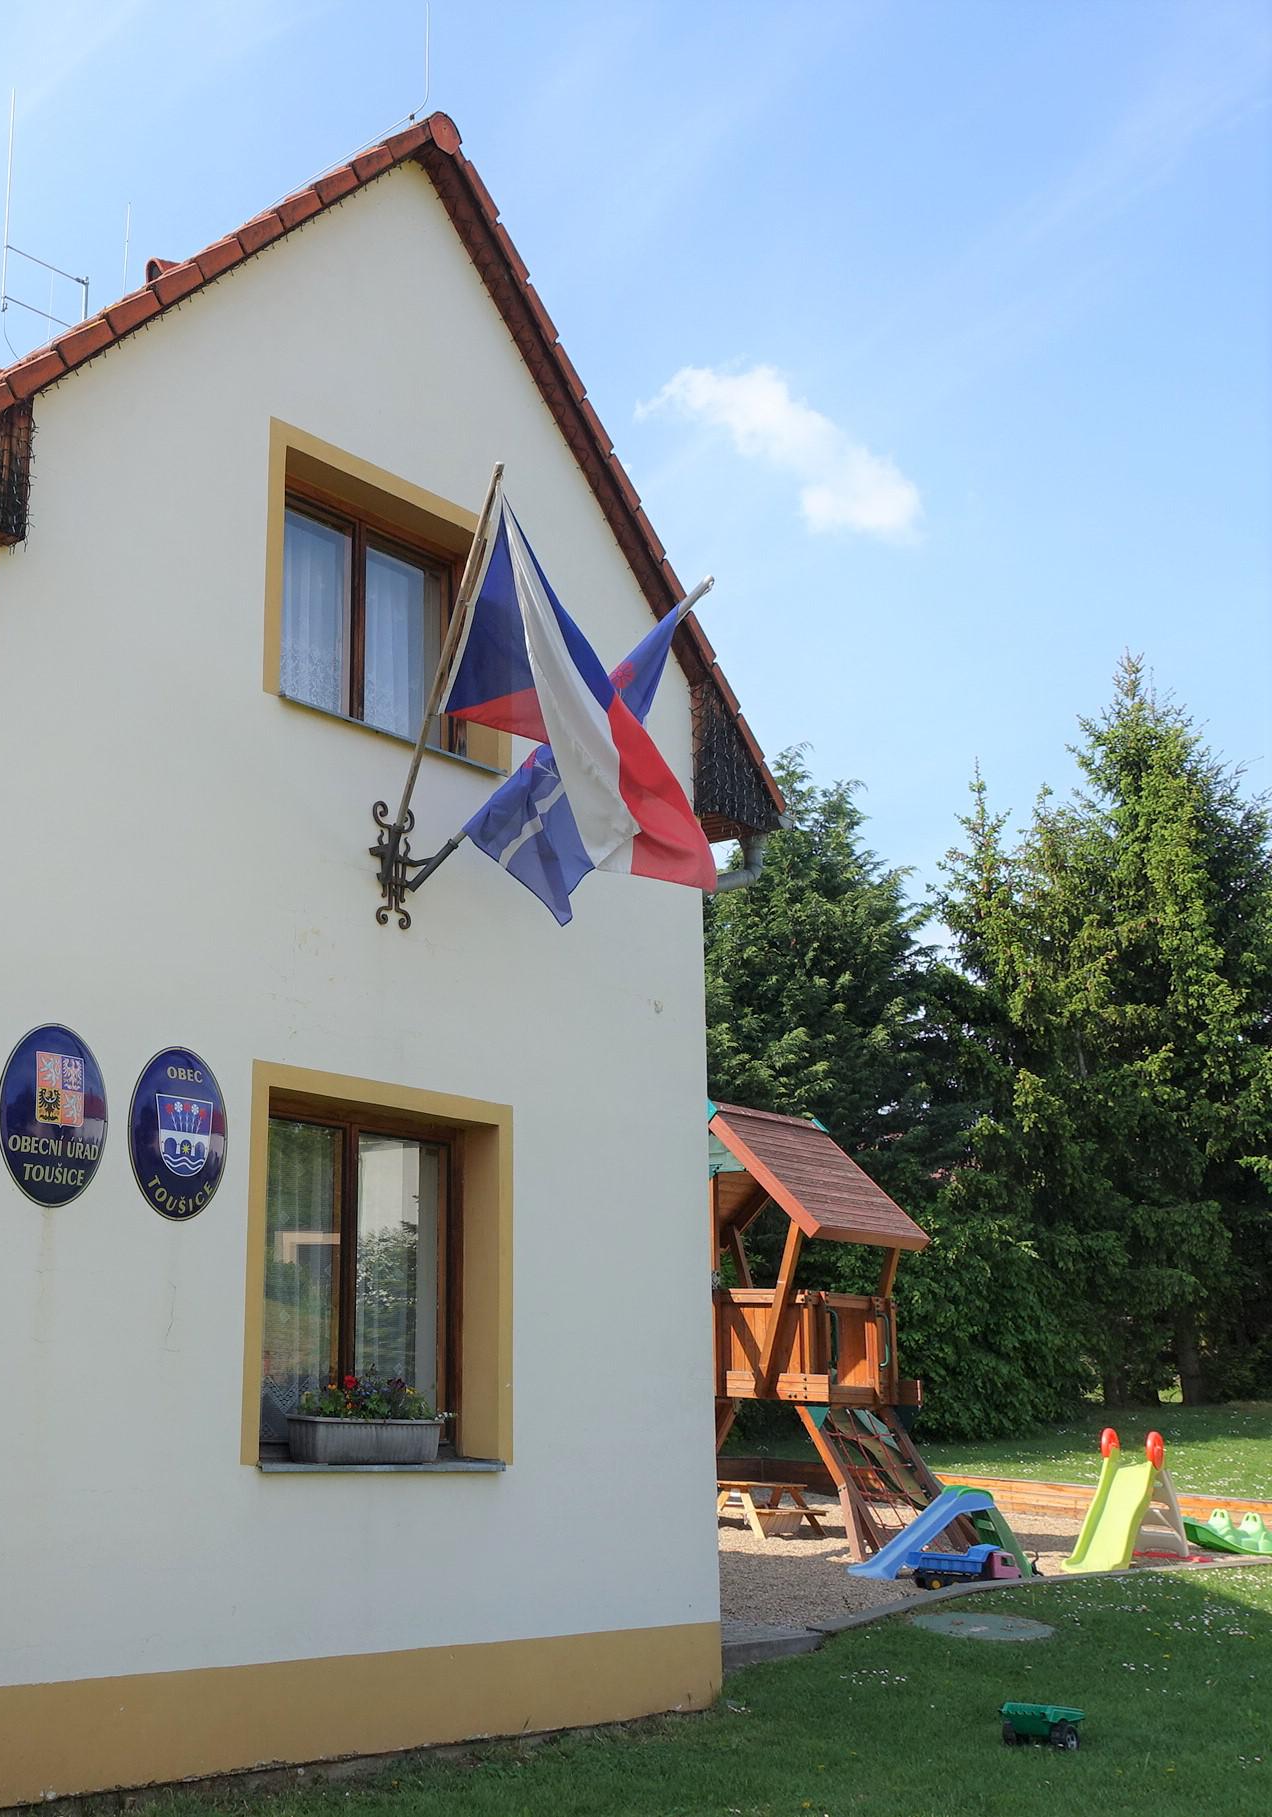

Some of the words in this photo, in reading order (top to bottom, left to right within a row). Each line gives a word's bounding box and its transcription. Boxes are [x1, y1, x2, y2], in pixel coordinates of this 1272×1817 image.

[167, 1066, 203, 1083] OBEC
[8, 1135, 62, 1157] OBECNÍ
[66, 1137, 99, 1161] ÚŘAD
[23, 1162, 84, 1186] TOUŠICE
[147, 1175, 212, 1214] TOUŠICE
